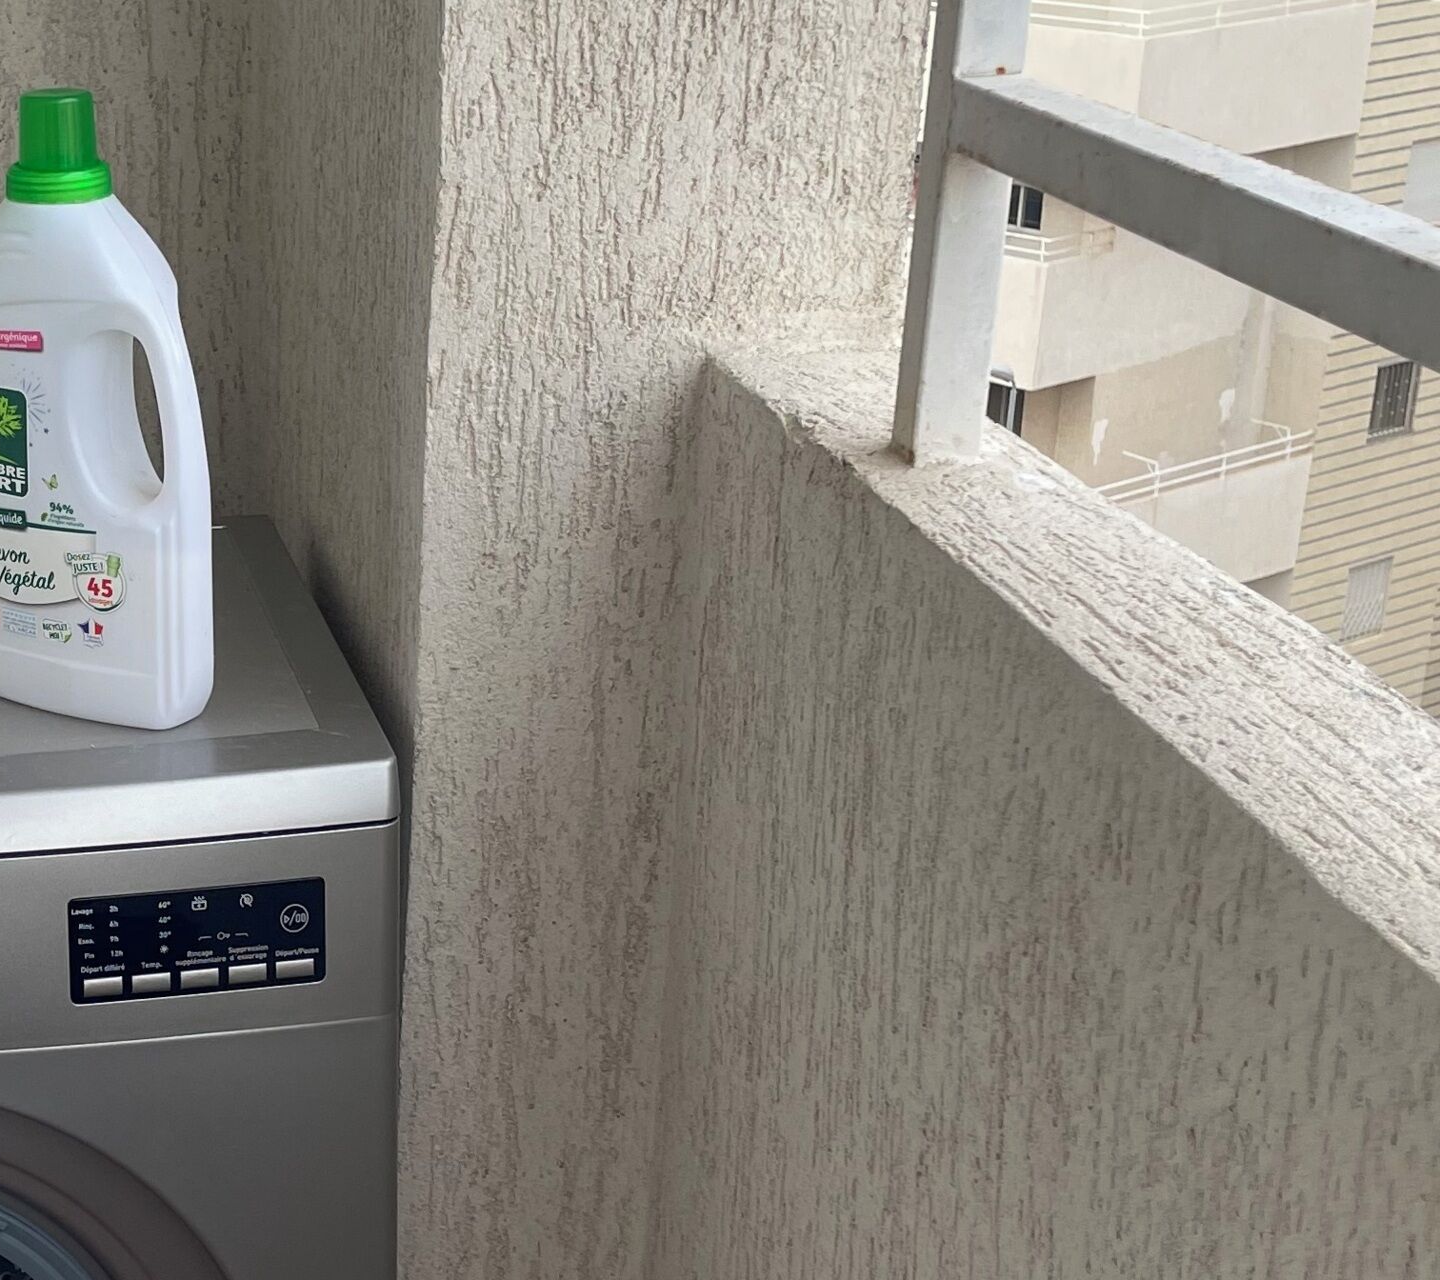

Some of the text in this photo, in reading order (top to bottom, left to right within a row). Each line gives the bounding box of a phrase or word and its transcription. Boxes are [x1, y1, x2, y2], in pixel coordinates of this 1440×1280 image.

[49, 501, 74, 515] 94%
[66, 552, 90, 561] Dosez
[73, 562, 97, 574] JUSTE
[87, 577, 113, 598] 45
